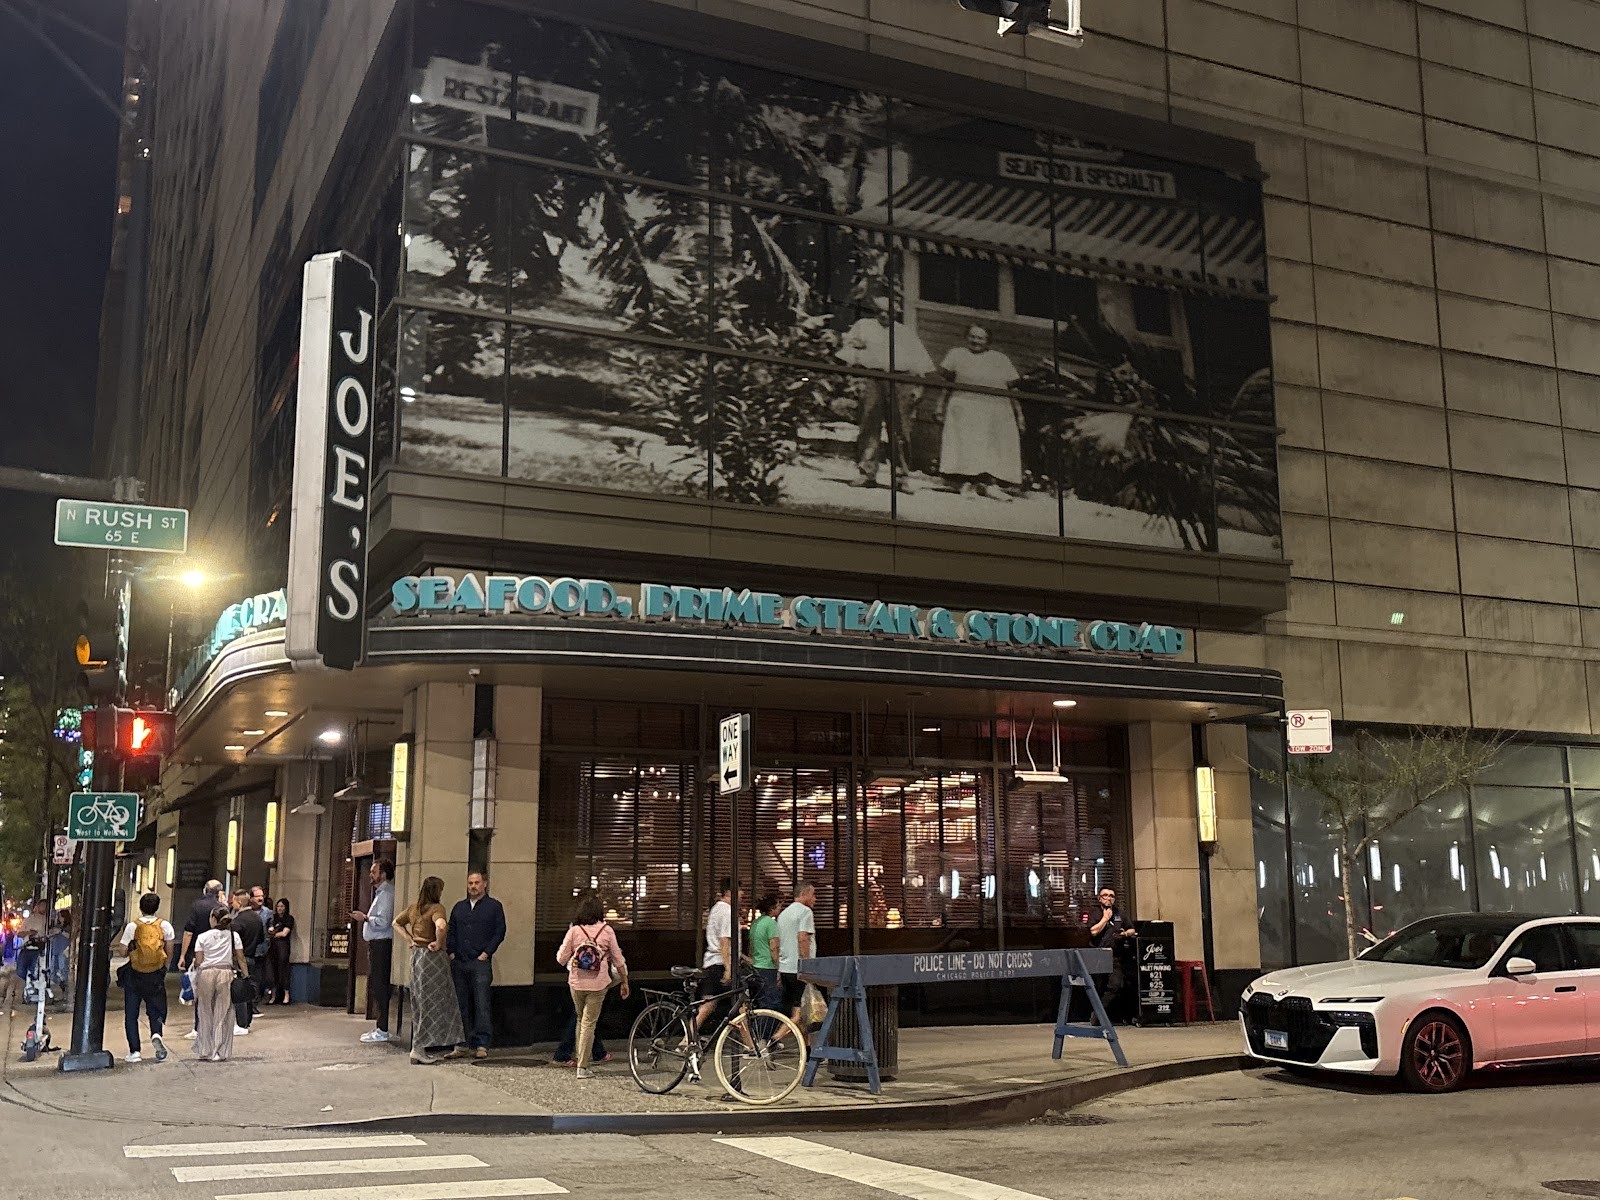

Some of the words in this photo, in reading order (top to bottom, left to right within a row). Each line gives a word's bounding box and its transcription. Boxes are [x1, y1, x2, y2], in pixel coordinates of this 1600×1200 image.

[328, 309, 373, 622] JOE'S
[66, 508, 76, 520] N
[85, 507, 153, 530] RUSH
[161, 517, 178, 529] ST
[105, 529, 122, 542] 65
[131, 531, 139, 544] E
[640, 583, 785, 629] PRIME
[790, 596, 922, 640] STEAK
[927, 607, 963, 642] &
[964, 610, 1083, 652] STONE
[1084, 620, 1187, 658] CRAB
[722, 722, 738, 742] ONE
[722, 742, 738, 762] WAY
[914, 955, 944, 973] POLICE
[988, 953, 1004, 969] NOT
[1006, 952, 1033, 969] CROSS
[1150, 981, 1164, 989] $25
